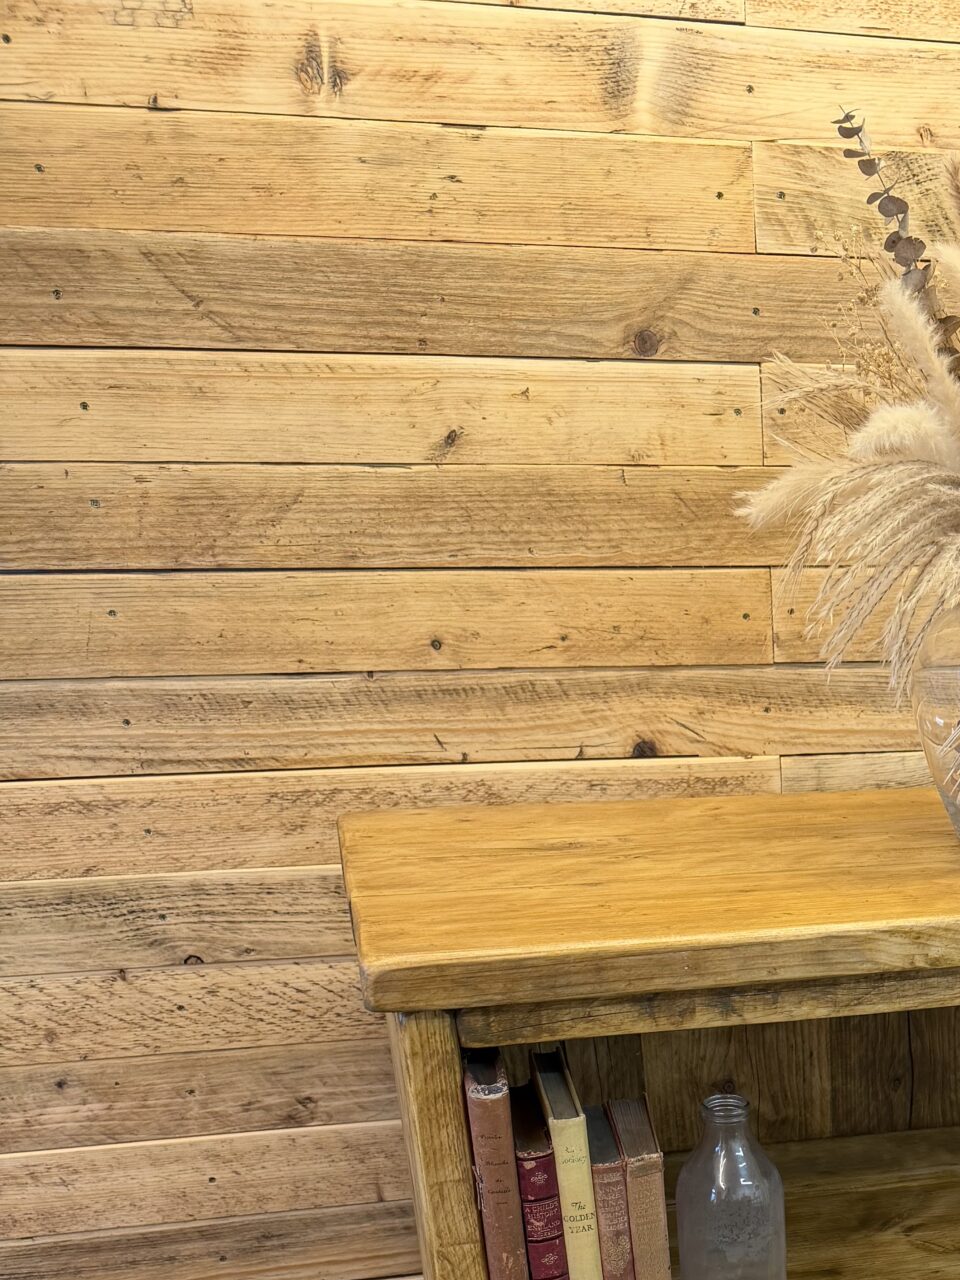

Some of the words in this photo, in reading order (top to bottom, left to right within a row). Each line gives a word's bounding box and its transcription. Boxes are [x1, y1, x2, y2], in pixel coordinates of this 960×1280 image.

[571, 1201, 587, 1211] The
[563, 1212, 596, 1223] GOLDEN
[568, 1224, 594, 1234] YEAR
